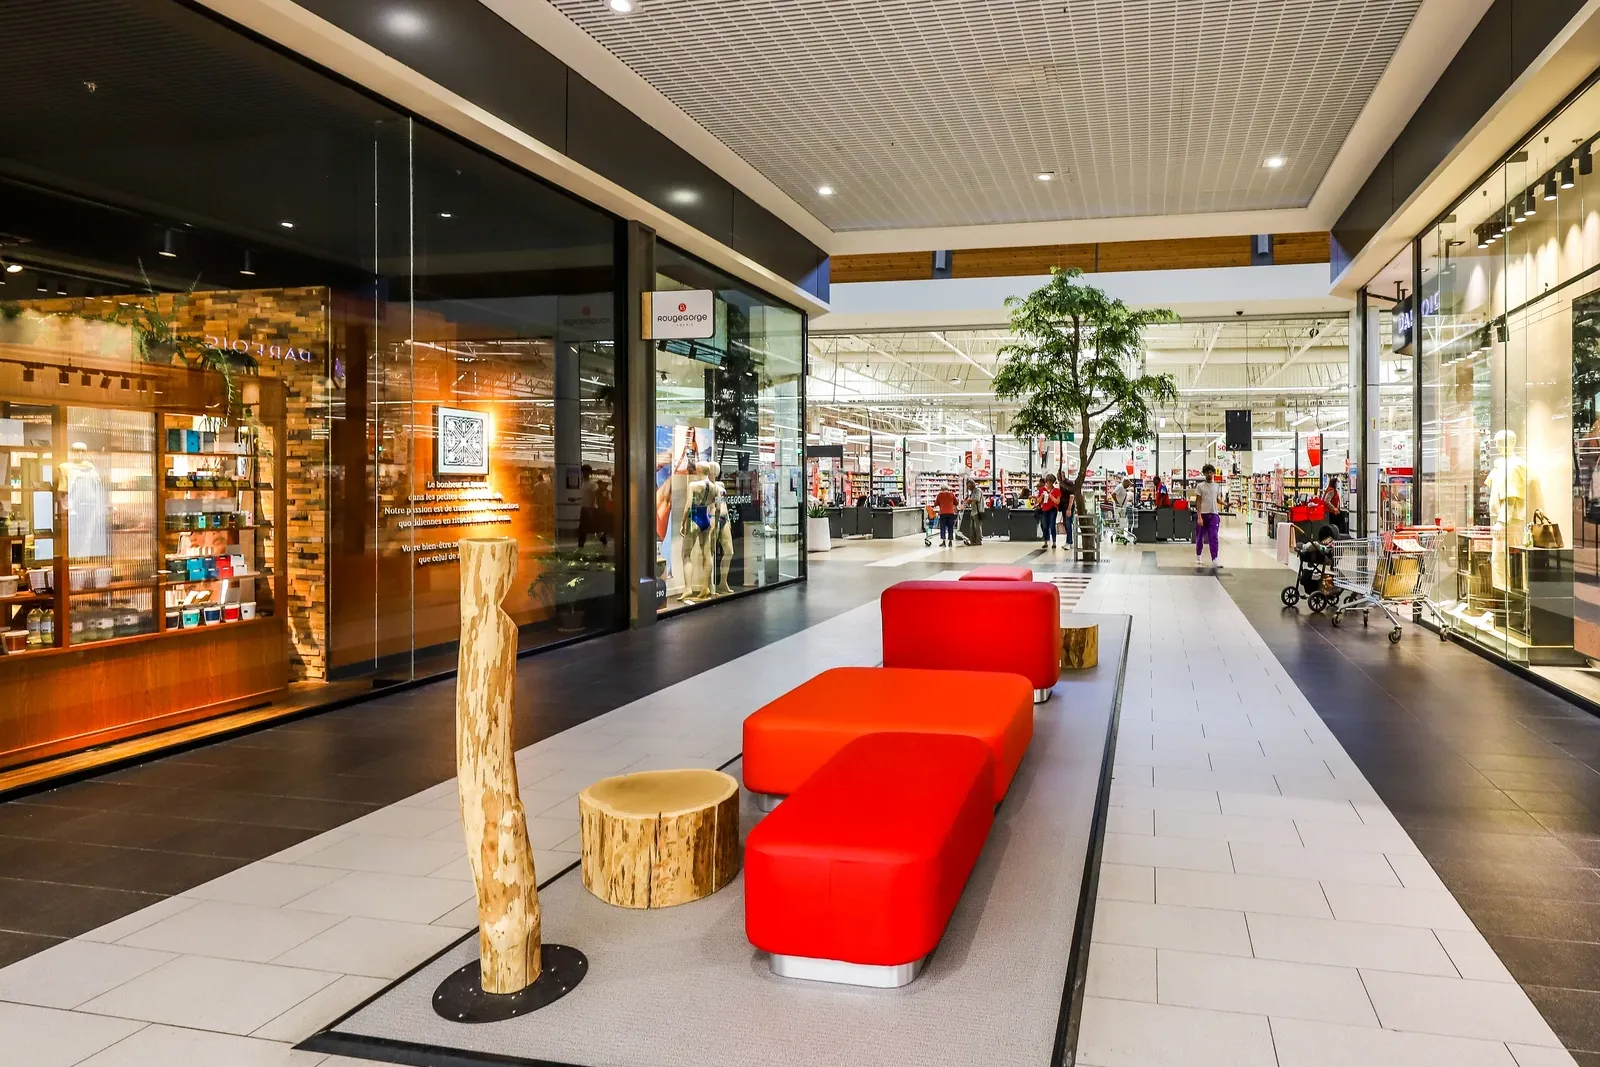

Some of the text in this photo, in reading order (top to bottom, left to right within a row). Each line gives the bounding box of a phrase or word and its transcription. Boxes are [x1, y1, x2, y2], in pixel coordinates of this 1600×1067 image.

[384, 507, 406, 515] Notre
[398, 519, 442, 528] quoidiennes
[418, 556, 431, 565] que
[431, 553, 448, 561] celui
[448, 552, 457, 560] de
